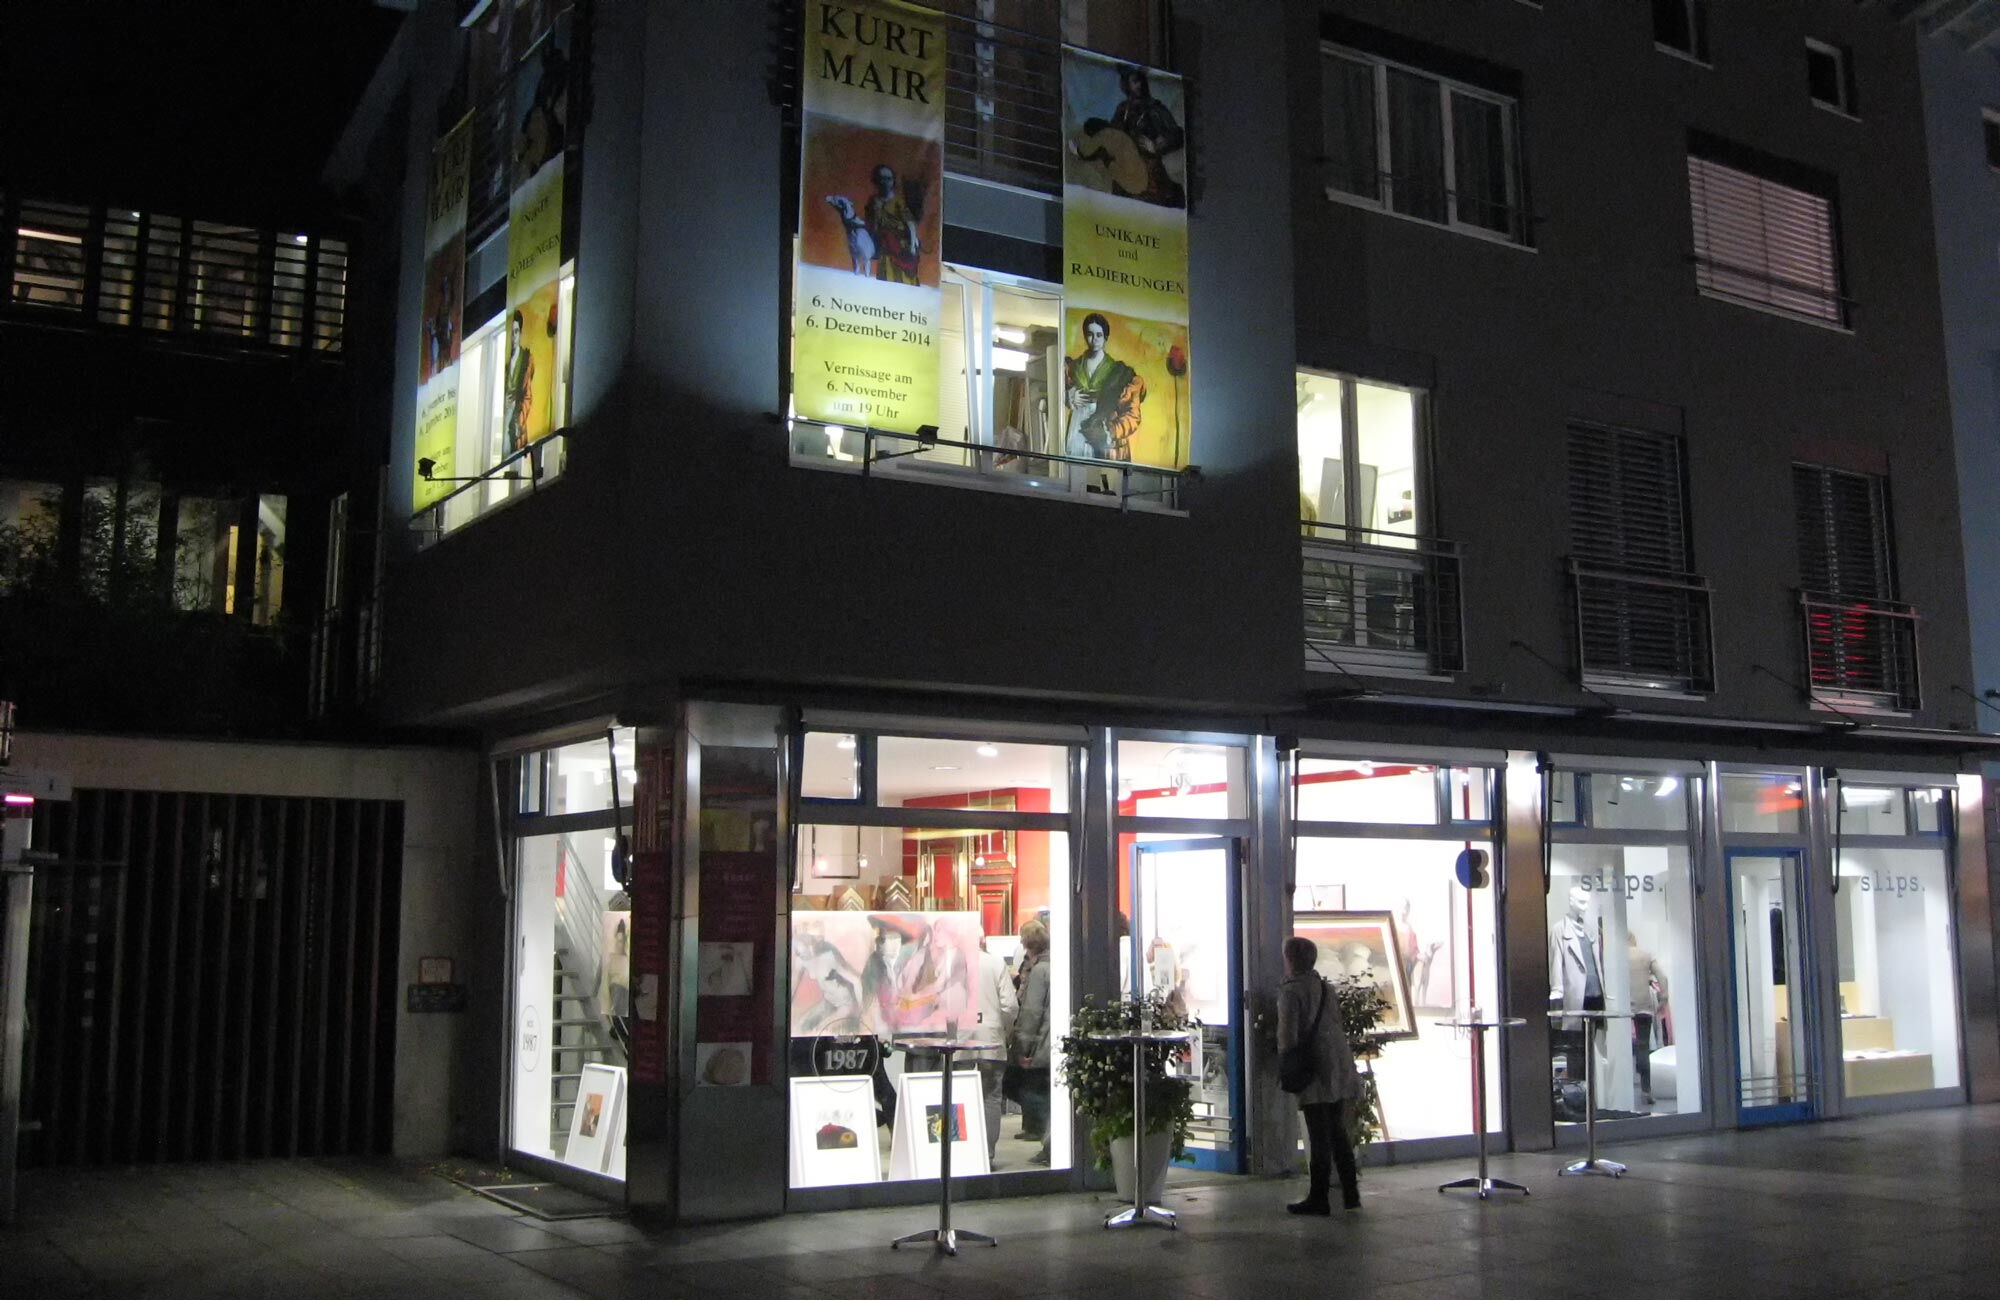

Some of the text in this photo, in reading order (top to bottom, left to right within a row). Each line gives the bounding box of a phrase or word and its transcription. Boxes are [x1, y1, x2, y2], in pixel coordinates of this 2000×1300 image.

[819, 3, 933, 60] KURT
[821, 47, 930, 105] MAIR
[1094, 224, 1160, 249] UNIKATE
[1118, 248, 1139, 262] und
[1071, 262, 1185, 294] RADIERUNGEN
[811, 295, 928, 326] 6. November bis
[805, 315, 931, 347] 6. Dezember 2014
[824, 360, 913, 385] Vernissage am
[826, 380, 908, 402] 6. November
[833, 401, 900, 419] um 19 Uhr
[1580, 867, 1663, 899] slips.
[1860, 869, 1925, 898] slips.
[824, 1049, 868, 1070] 1987
